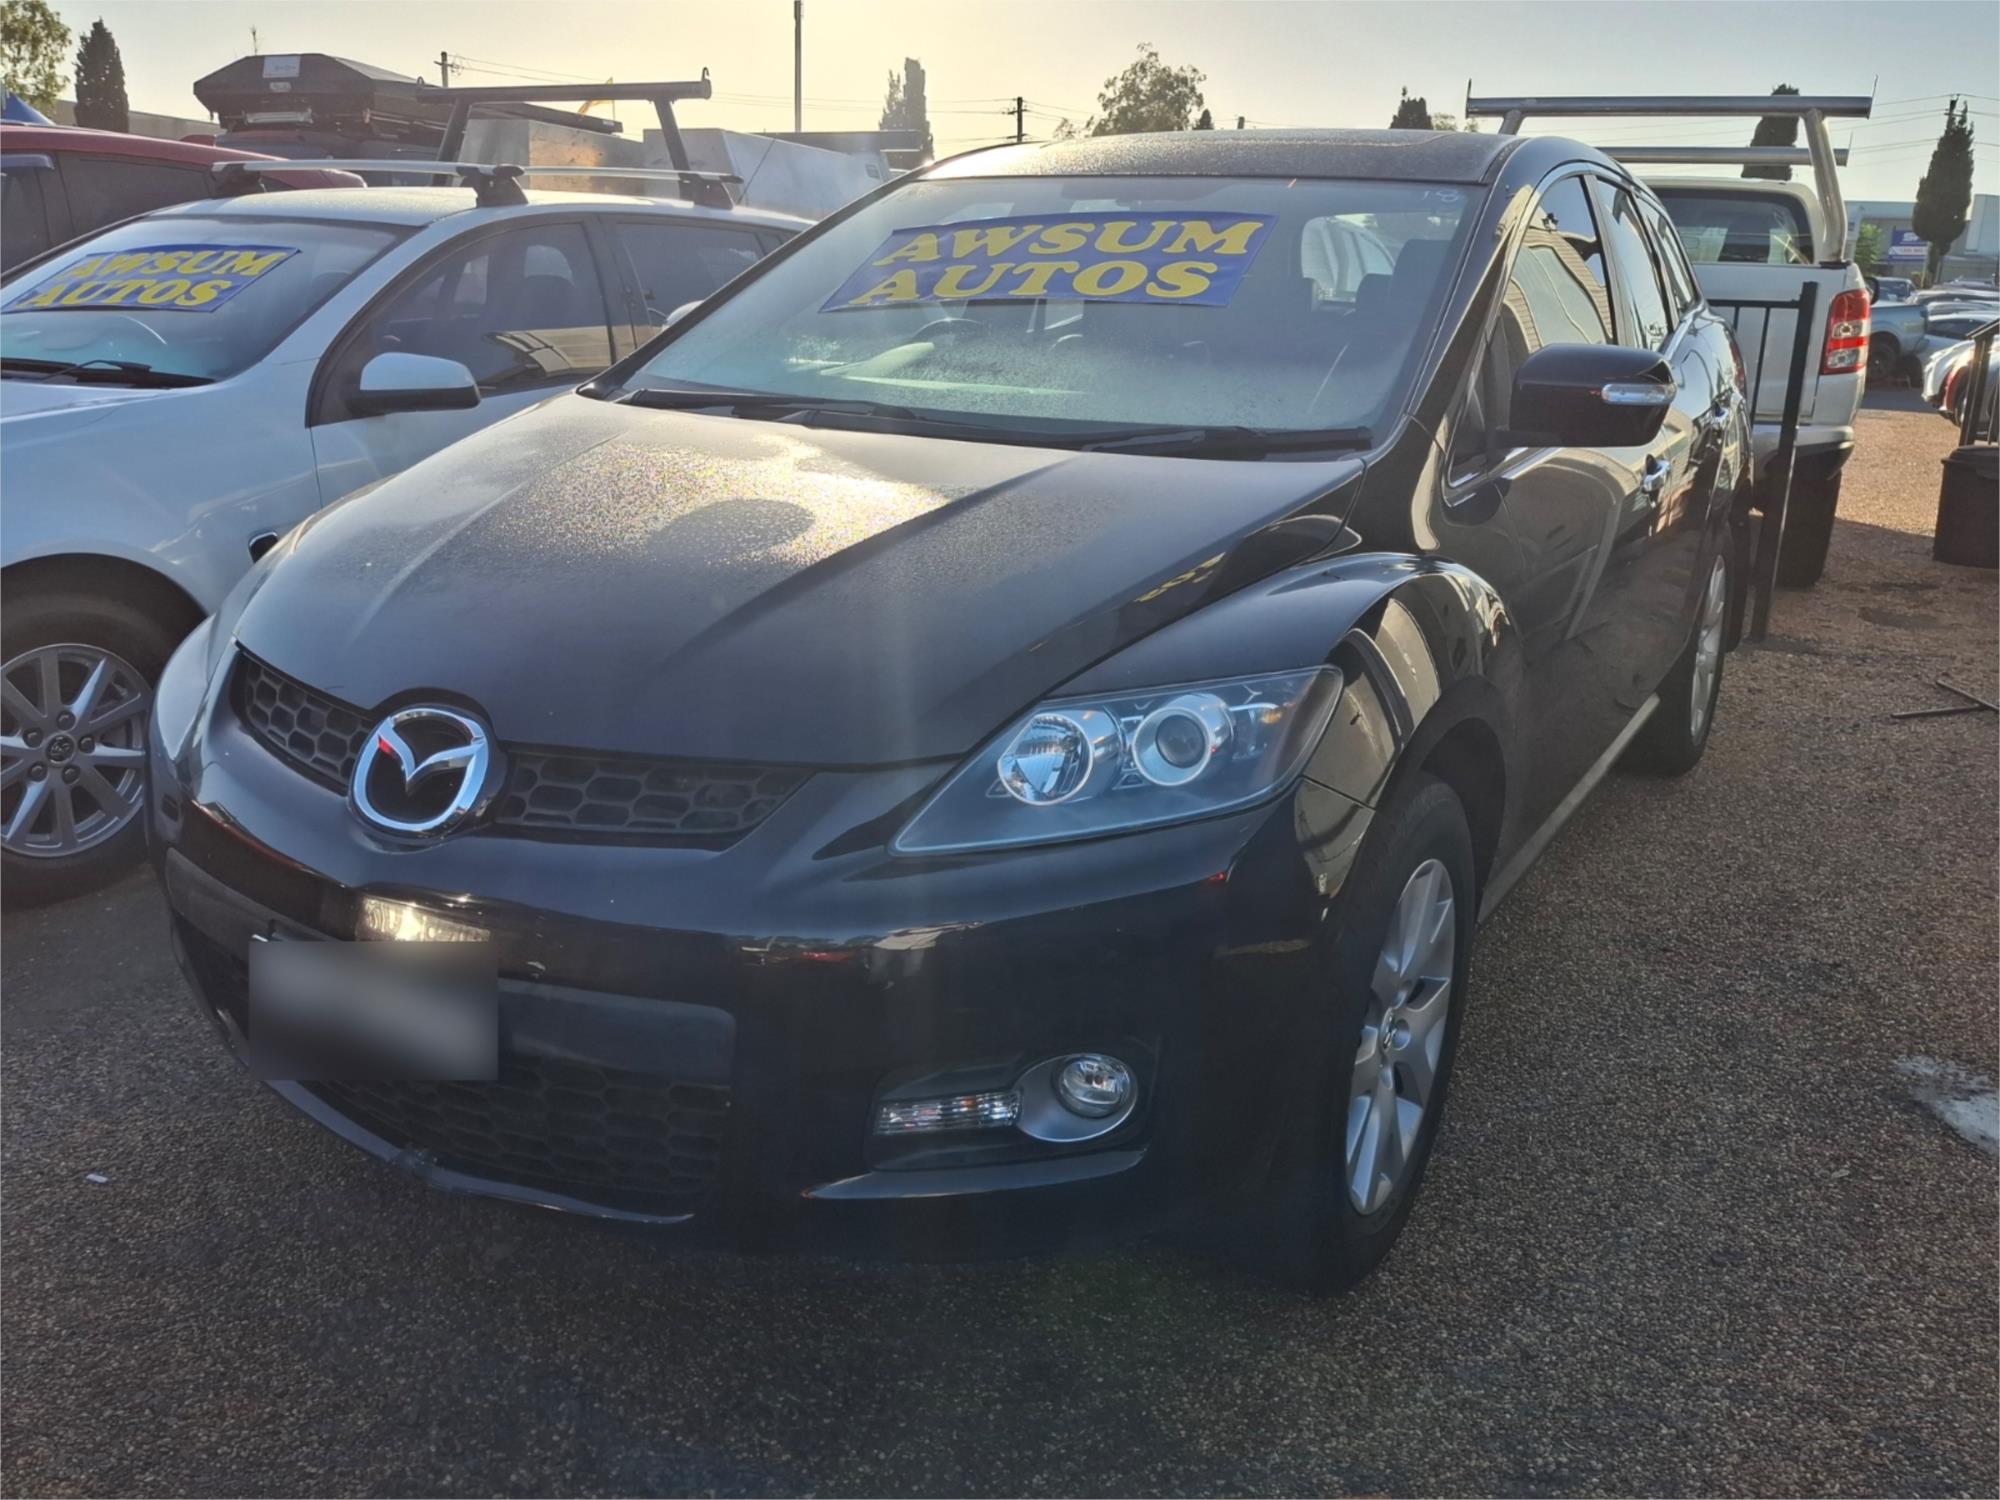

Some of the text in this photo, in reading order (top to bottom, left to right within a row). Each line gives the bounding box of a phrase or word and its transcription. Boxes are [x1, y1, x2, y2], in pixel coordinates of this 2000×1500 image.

[872, 220, 1264, 266] AWSUM
[57, 250, 287, 279] AWSUM
[849, 260, 1218, 304] AUTOS
[15, 278, 232, 308] AUTOS
